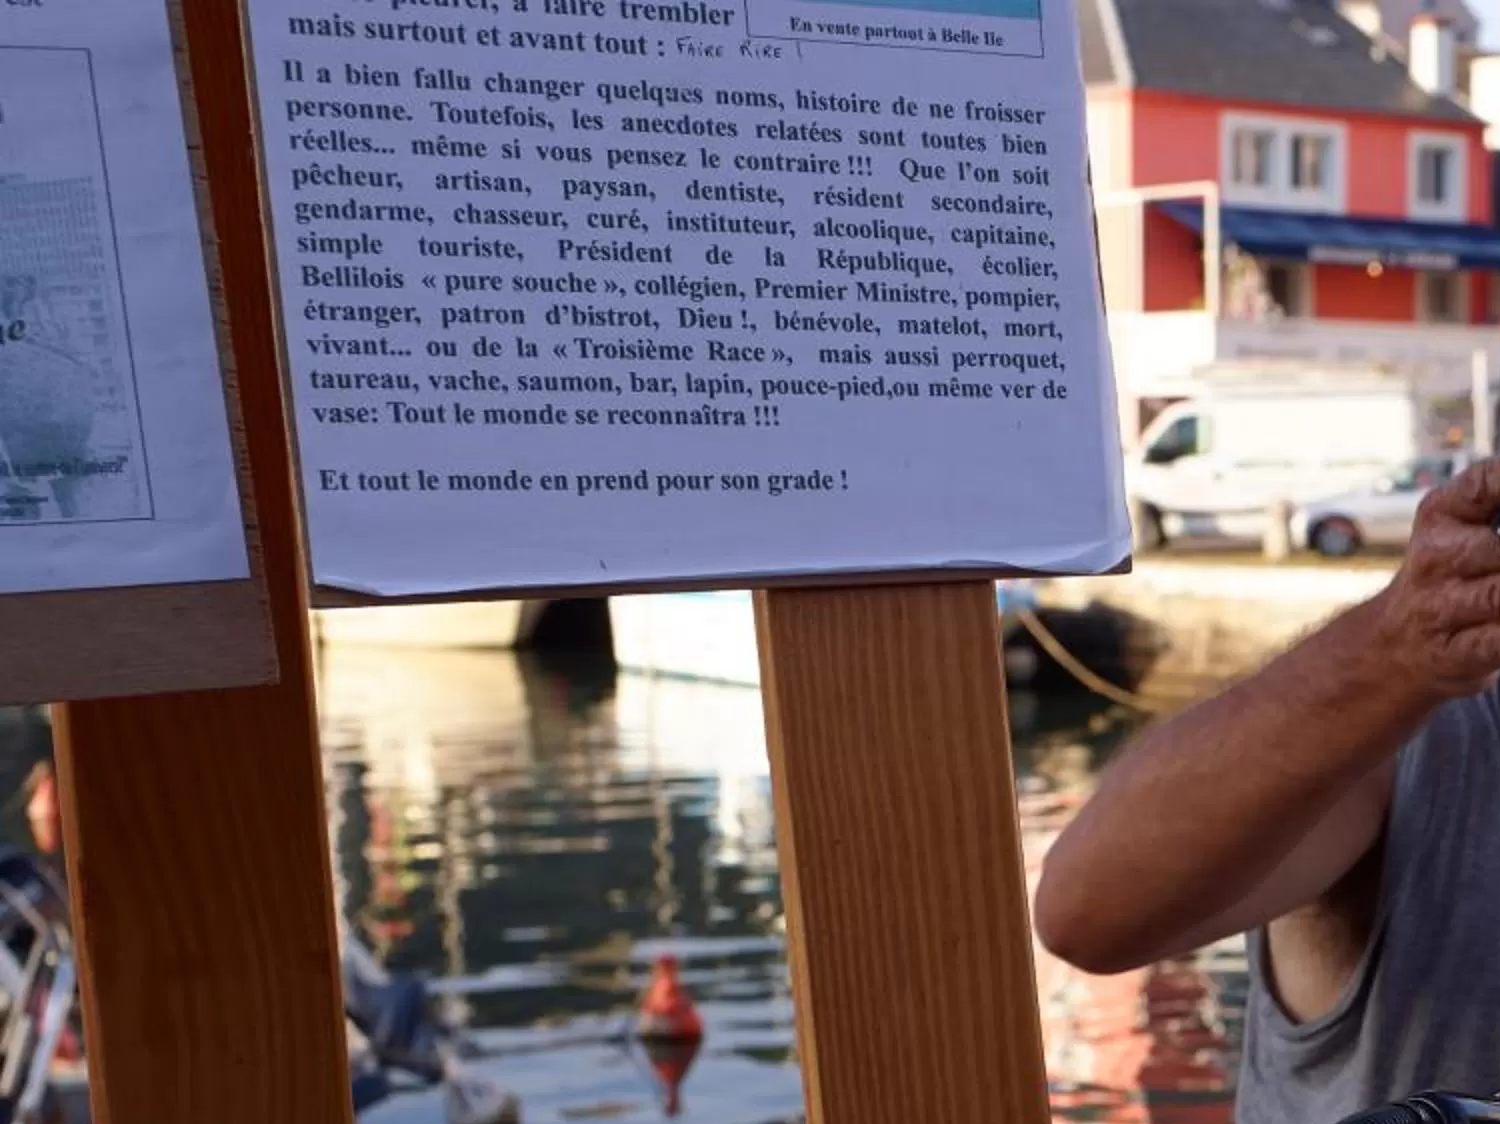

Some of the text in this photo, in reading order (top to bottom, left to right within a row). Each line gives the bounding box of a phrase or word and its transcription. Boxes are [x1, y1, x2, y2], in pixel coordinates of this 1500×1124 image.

[288, 13, 356, 38] mais
[364, 21, 466, 45] surtout
[476, 26, 500, 47] et
[509, 32, 586, 52] avant
[594, 32, 648, 56] tout
[620, 0, 735, 26] trembler
[282, 60, 1046, 125] Il a bien fallu changer quelques noms, histoire de ne froisser
[285, 100, 1048, 155] personne. Toutefois, les anecdotes relatées sont toutes bien
[411, 134, 487, 158] même
[501, 138, 521, 160] si
[536, 146, 592, 163] vous
[607, 149, 687, 170] pensez
[700, 148, 720, 169] le
[734, 153, 840, 175] contraire
[899, 158, 945, 183] Que
[1012, 166, 1049, 186] soit
[292, 162, 1053, 221] pêcheur, artisan, paysan, dentiste, résident secondaire,
[294, 198, 1055, 250] gendarme, chasseur, curé, instituteur, alcoolique, capitaine,
[297, 231, 1058, 281] simple touriste, Président de la République, écolier,
[300, 264, 404, 288] Bellilois
[444, 275, 503, 296] pure
[512, 272, 597, 293] souche
[634, 274, 746, 302] collégien,
[754, 278, 848, 301] Premier
[856, 282, 962, 308] Ministre,
[965, 287, 1060, 312] pompier,
[304, 299, 421, 328] étranger,
[441, 304, 525, 329] patron
[545, 304, 660, 332] d'bistrot,
[678, 307, 732, 329] Dieu
[774, 310, 880, 336] bénévole,
[898, 316, 988, 340] matelot,
[1004, 320, 1063, 342] mort,
[426, 341, 457, 357] ou
[472, 336, 502, 357] de
[516, 336, 538, 358] la
[573, 337, 693, 361] Troisième
[706, 340, 765, 362] Race
[819, 344, 872, 364] mais
[884, 346, 940, 367] aussi
[952, 351, 1065, 374] perroquet,
[310, 370, 420, 393] taureau,
[428, 369, 509, 393] vache,
[517, 376, 622, 396] saumon,
[629, 372, 677, 397] bar,
[685, 372, 752, 399] lapin,
[928, 377, 993, 398] même
[1000, 384, 1036, 399] ver
[1042, 379, 1068, 399] de
[312, 407, 378, 424] vase:
[386, 401, 446, 424] Tout
[453, 402, 475, 424] le
[482, 404, 568, 425] monde
[574, 409, 599, 424] se
[607, 404, 746, 426] reconnaîtra
[319, 469, 350, 491] Et
[358, 472, 411, 491] tout
[417, 469, 439, 491] le
[447, 469, 532, 491] monde
[540, 475, 568, 491] en
[576, 469, 649, 496] prend
[656, 474, 715, 496] pour
[721, 474, 760, 490] son
[768, 469, 834, 496] grade
